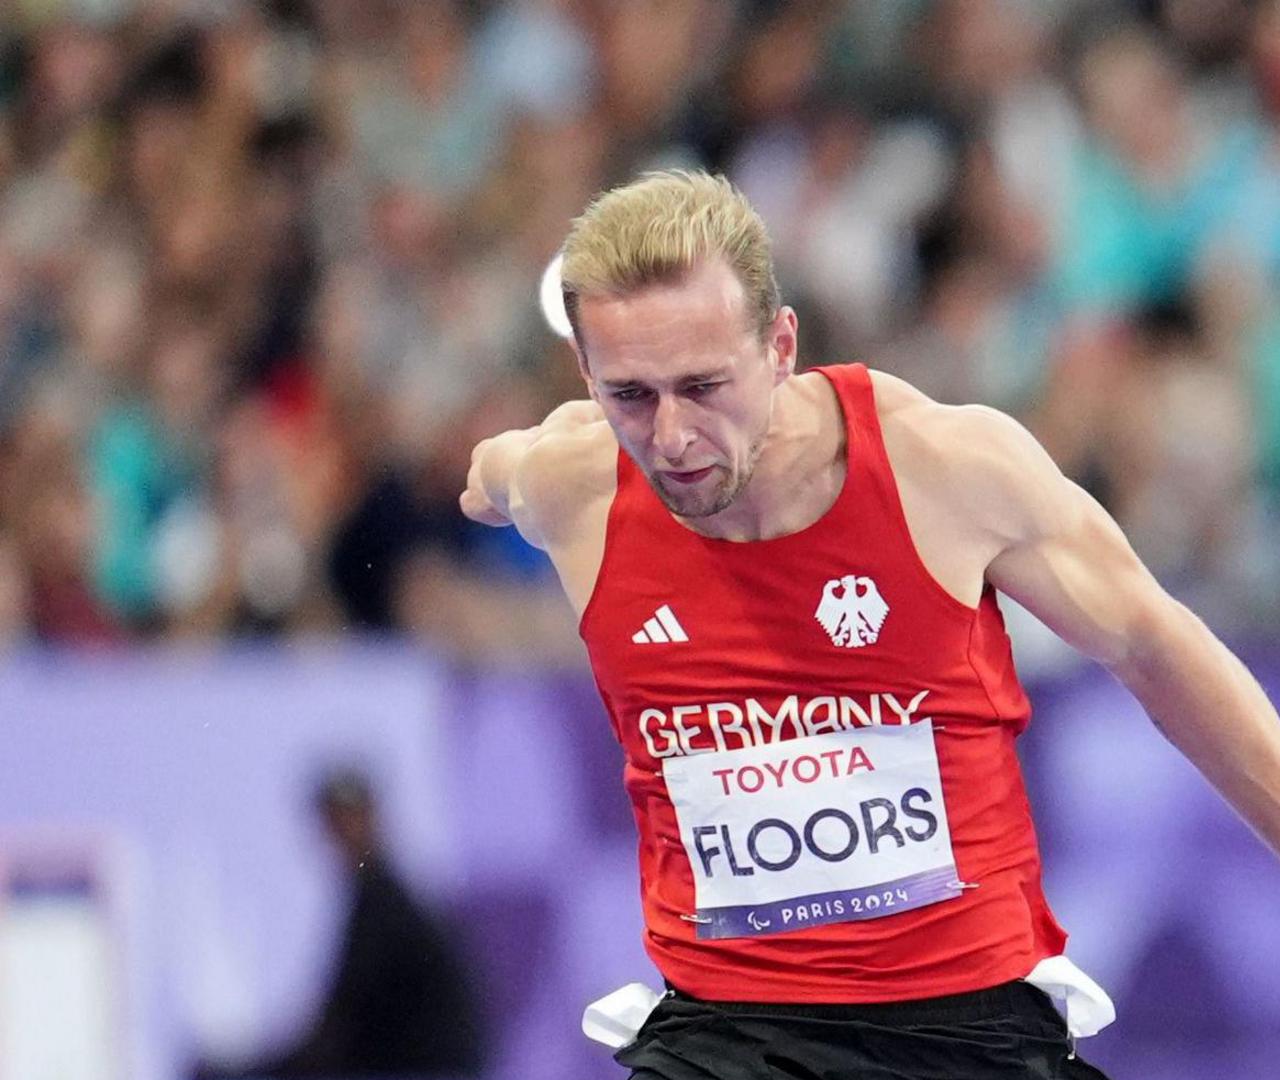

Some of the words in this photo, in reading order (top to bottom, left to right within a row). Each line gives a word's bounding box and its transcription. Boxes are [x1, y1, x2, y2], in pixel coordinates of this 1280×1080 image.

[638, 689, 930, 759] GERMANY
[713, 746, 875, 796] TOYOTA
[692, 787, 939, 878] FLOORS
[781, 900, 845, 924] PARIS
[851, 889, 908, 912] 2024
